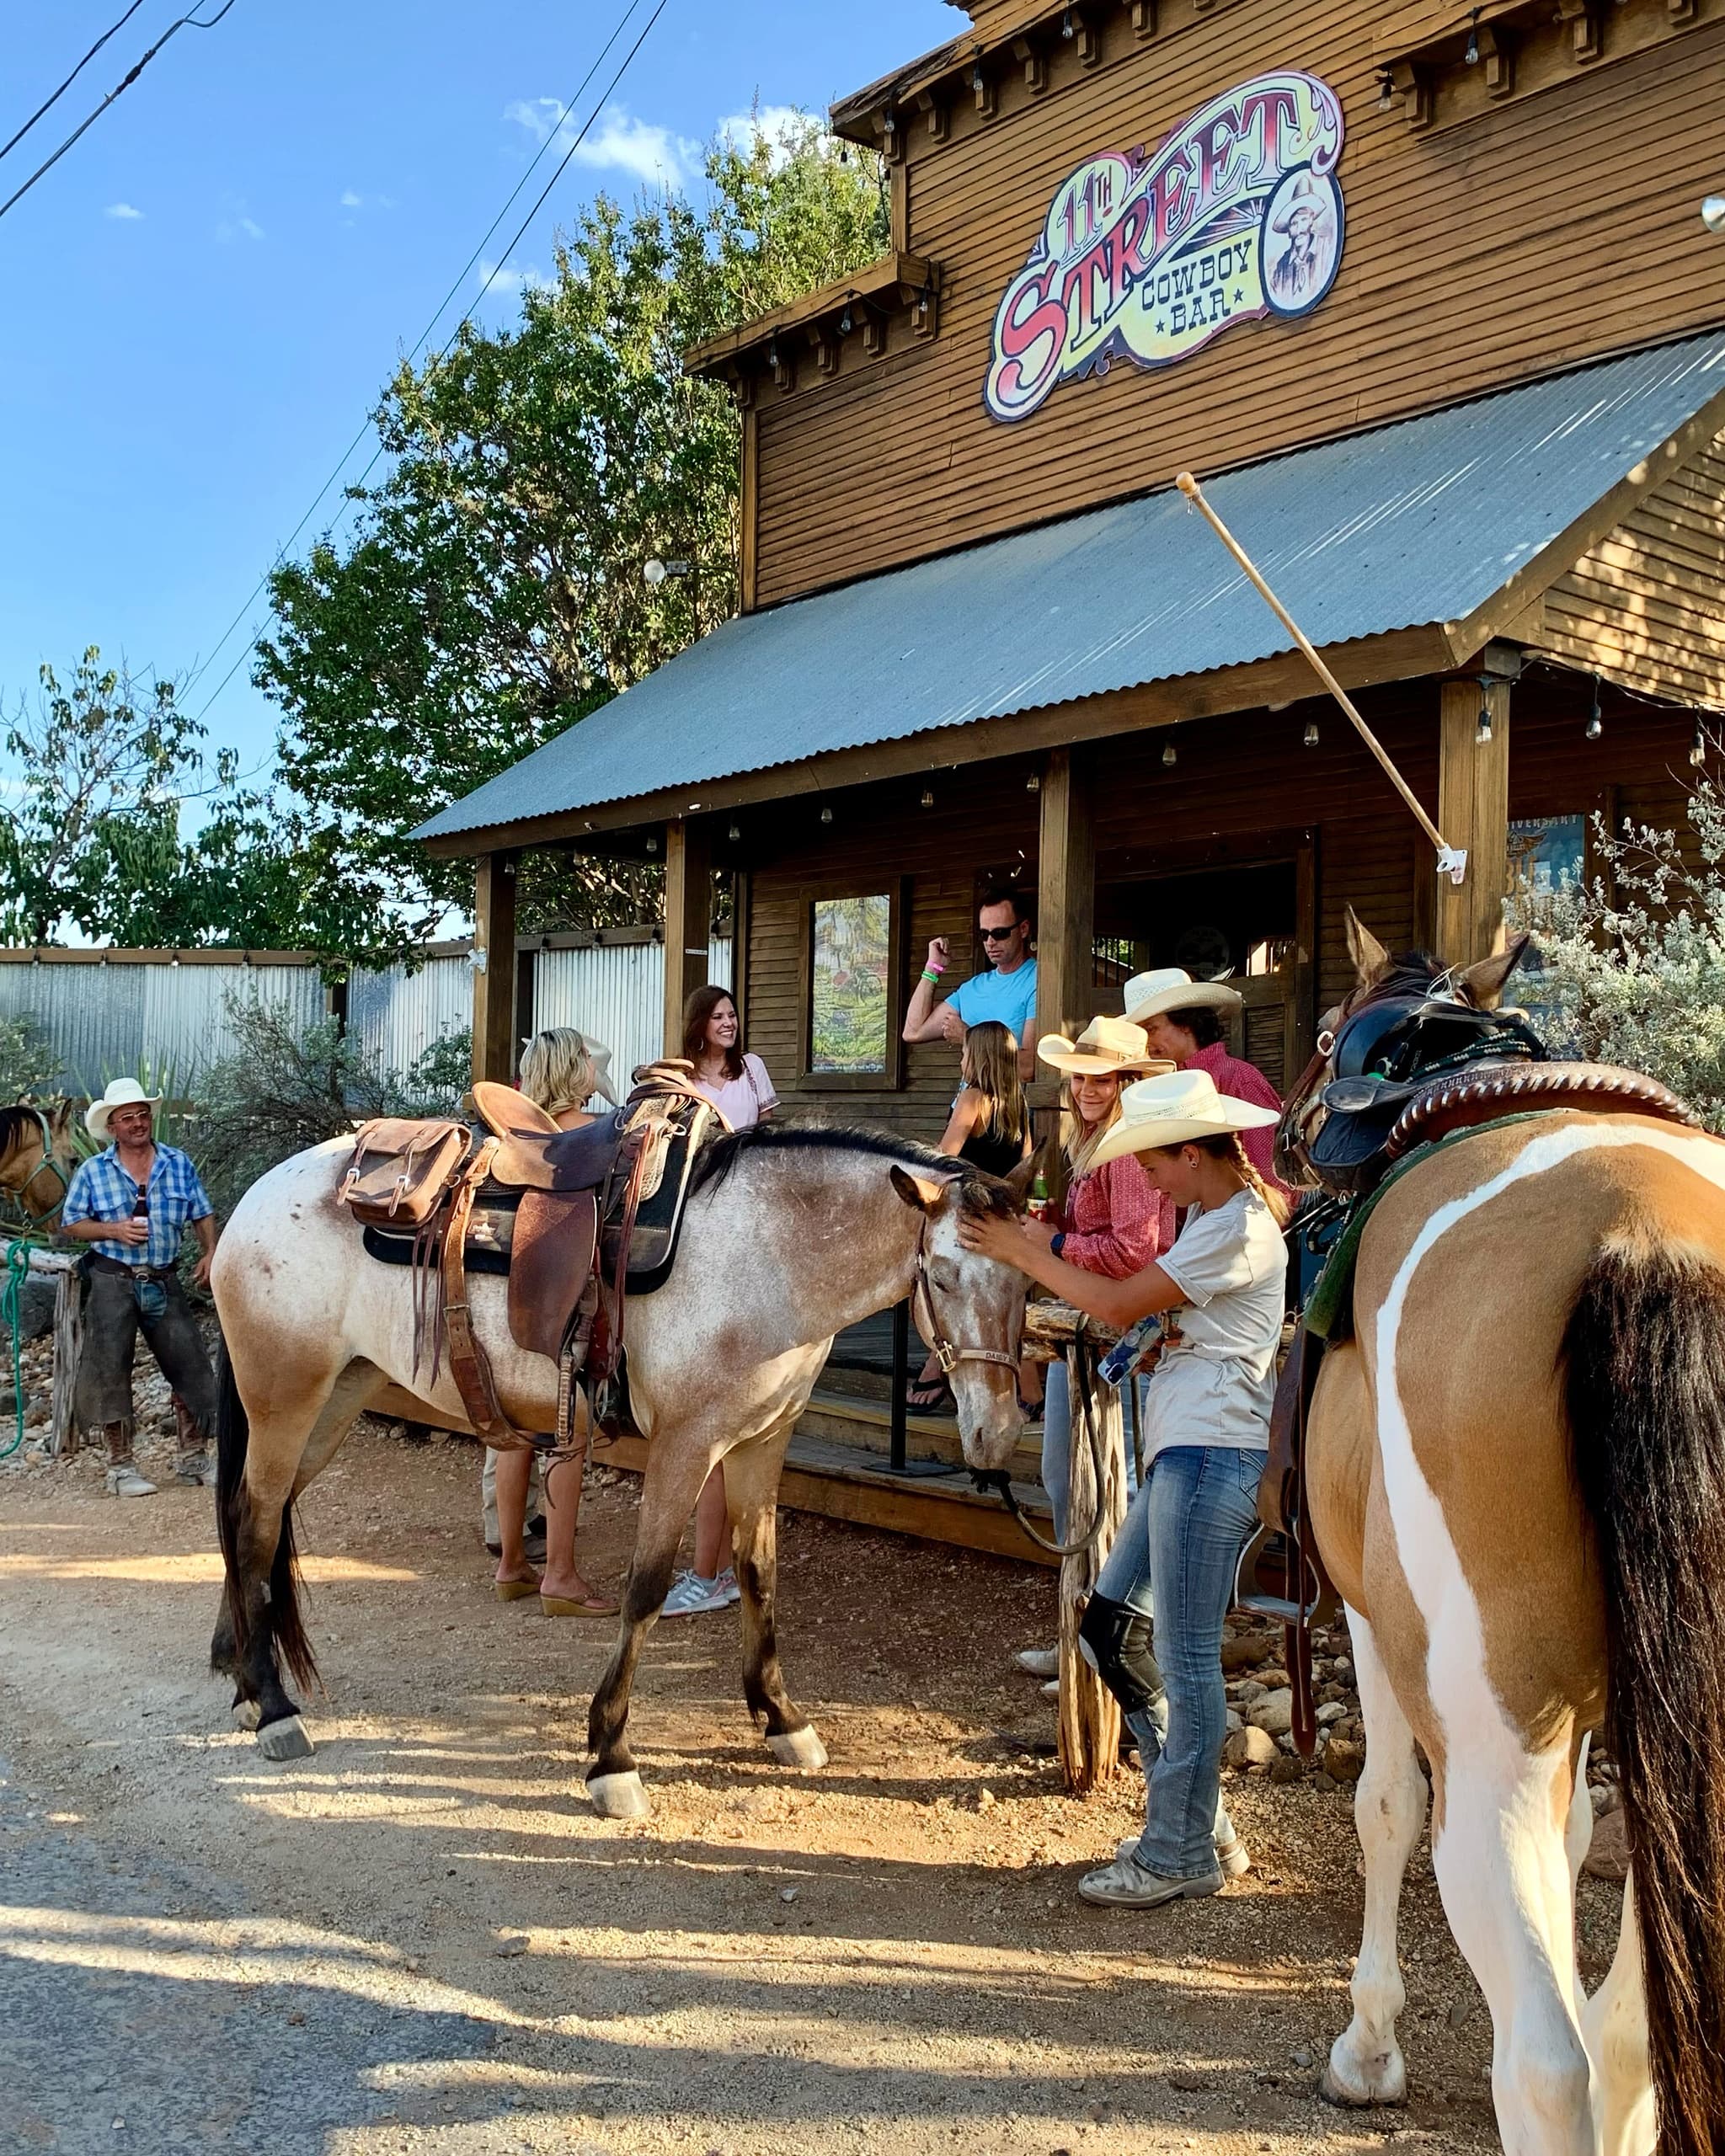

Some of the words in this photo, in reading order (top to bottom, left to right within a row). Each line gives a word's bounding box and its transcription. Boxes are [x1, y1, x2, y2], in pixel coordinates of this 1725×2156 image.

[996, 89, 1300, 407] STREET
[1056, 164, 1112, 268] 11TH
[1142, 237, 1252, 312] COWBOY
[1170, 287, 1231, 337] BAR
[1508, 814, 1577, 830] IVERSARY
